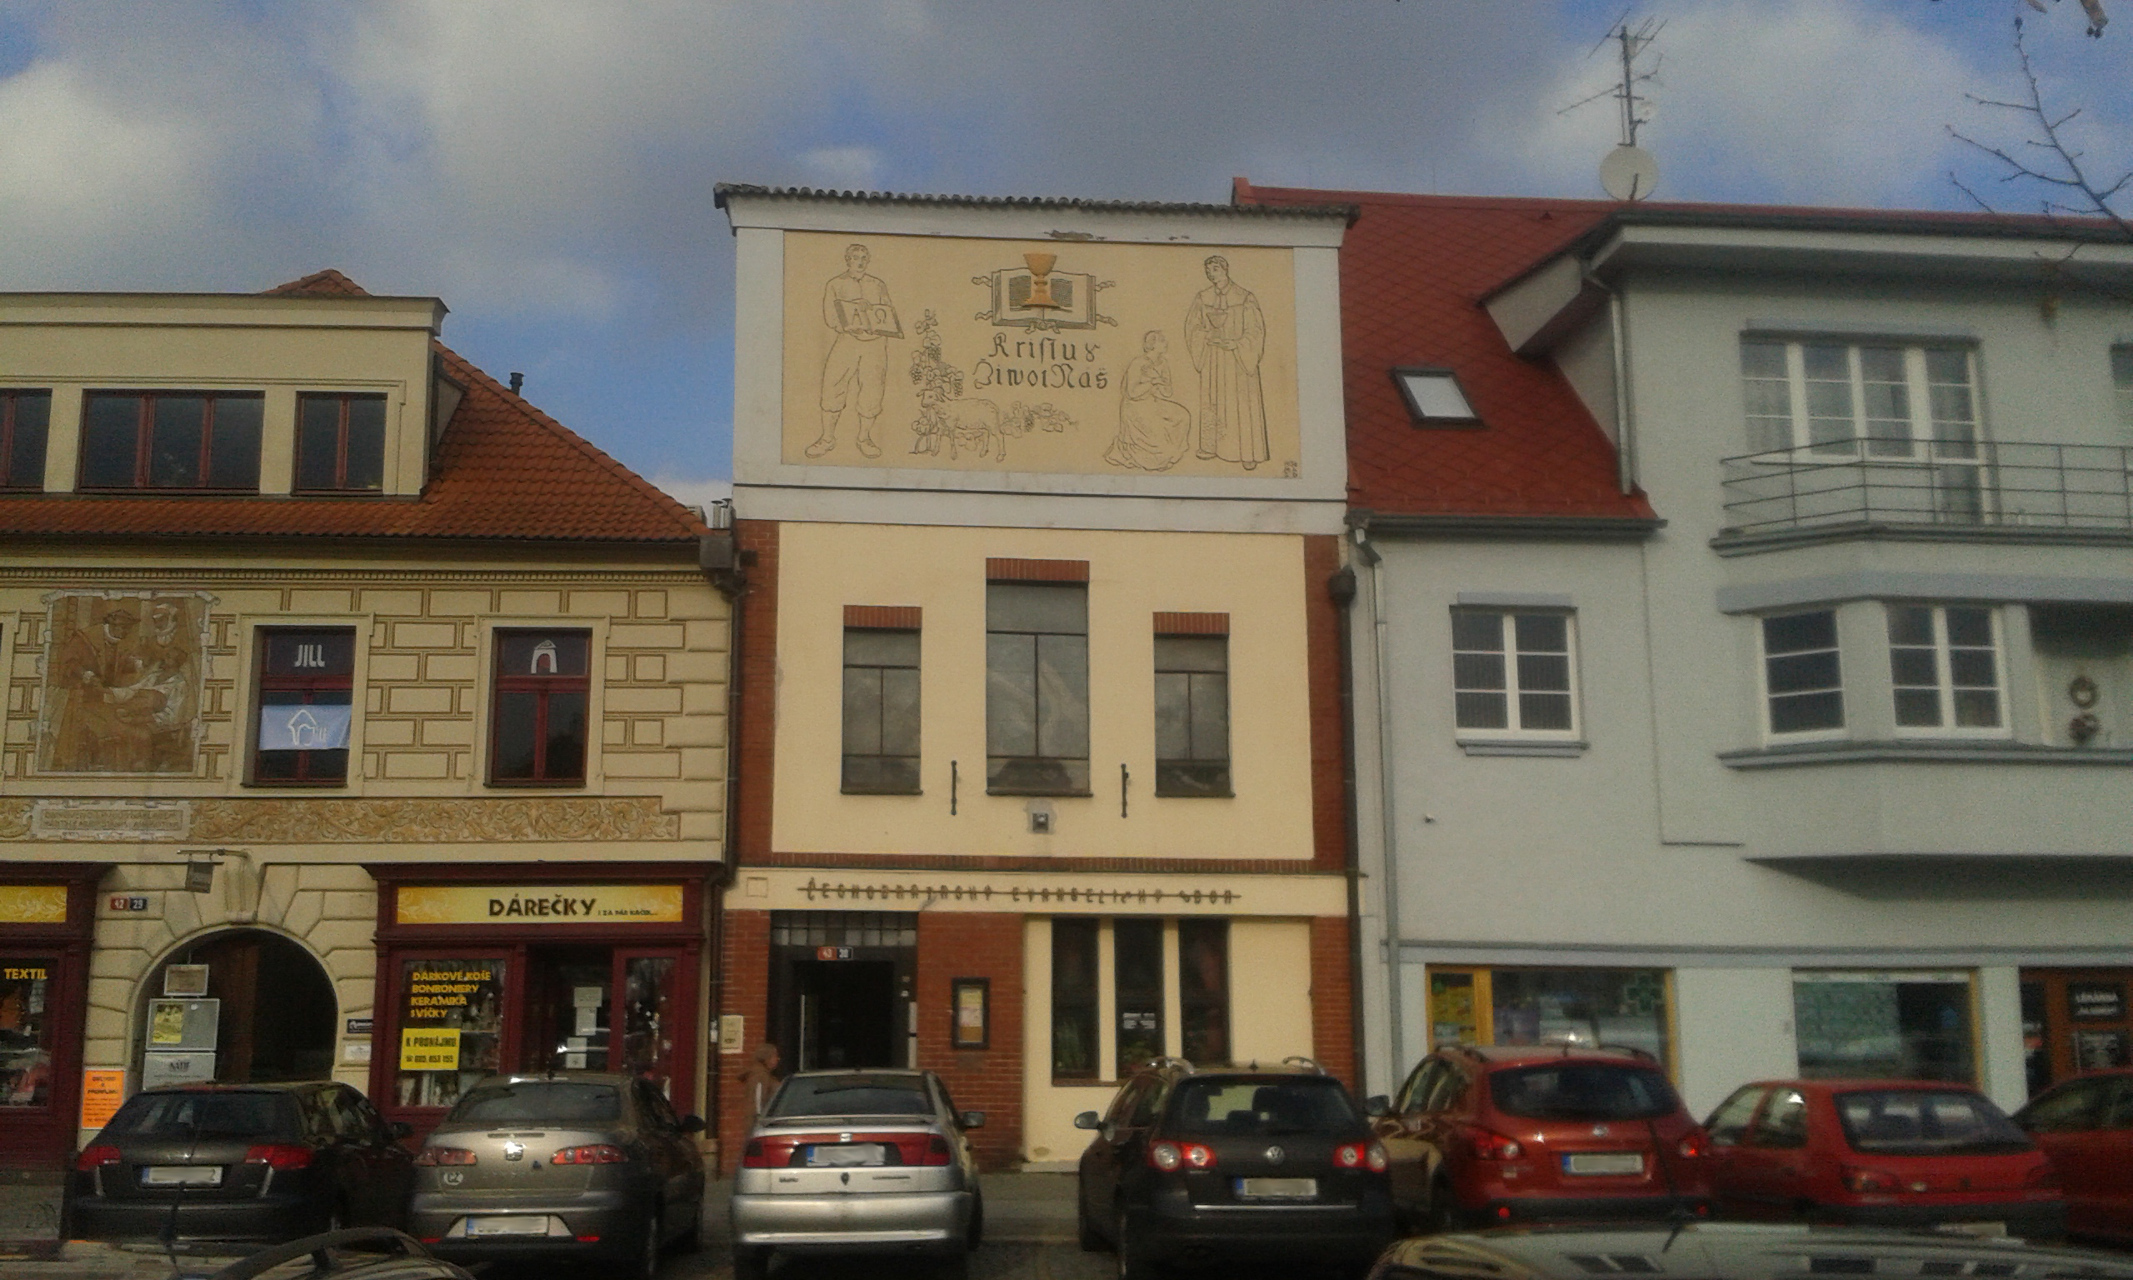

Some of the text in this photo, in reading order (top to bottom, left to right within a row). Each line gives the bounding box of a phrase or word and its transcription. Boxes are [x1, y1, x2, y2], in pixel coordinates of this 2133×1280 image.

[294, 644, 325, 668] JILL
[488, 893, 597, 916] DÁREČKY
[4, 968, 48, 980] TEXTIL
[465, 970, 491, 981] KOŠE
[410, 996, 468, 1006] KERAMIKA
[410, 1007, 448, 1018] SVÍČKY
